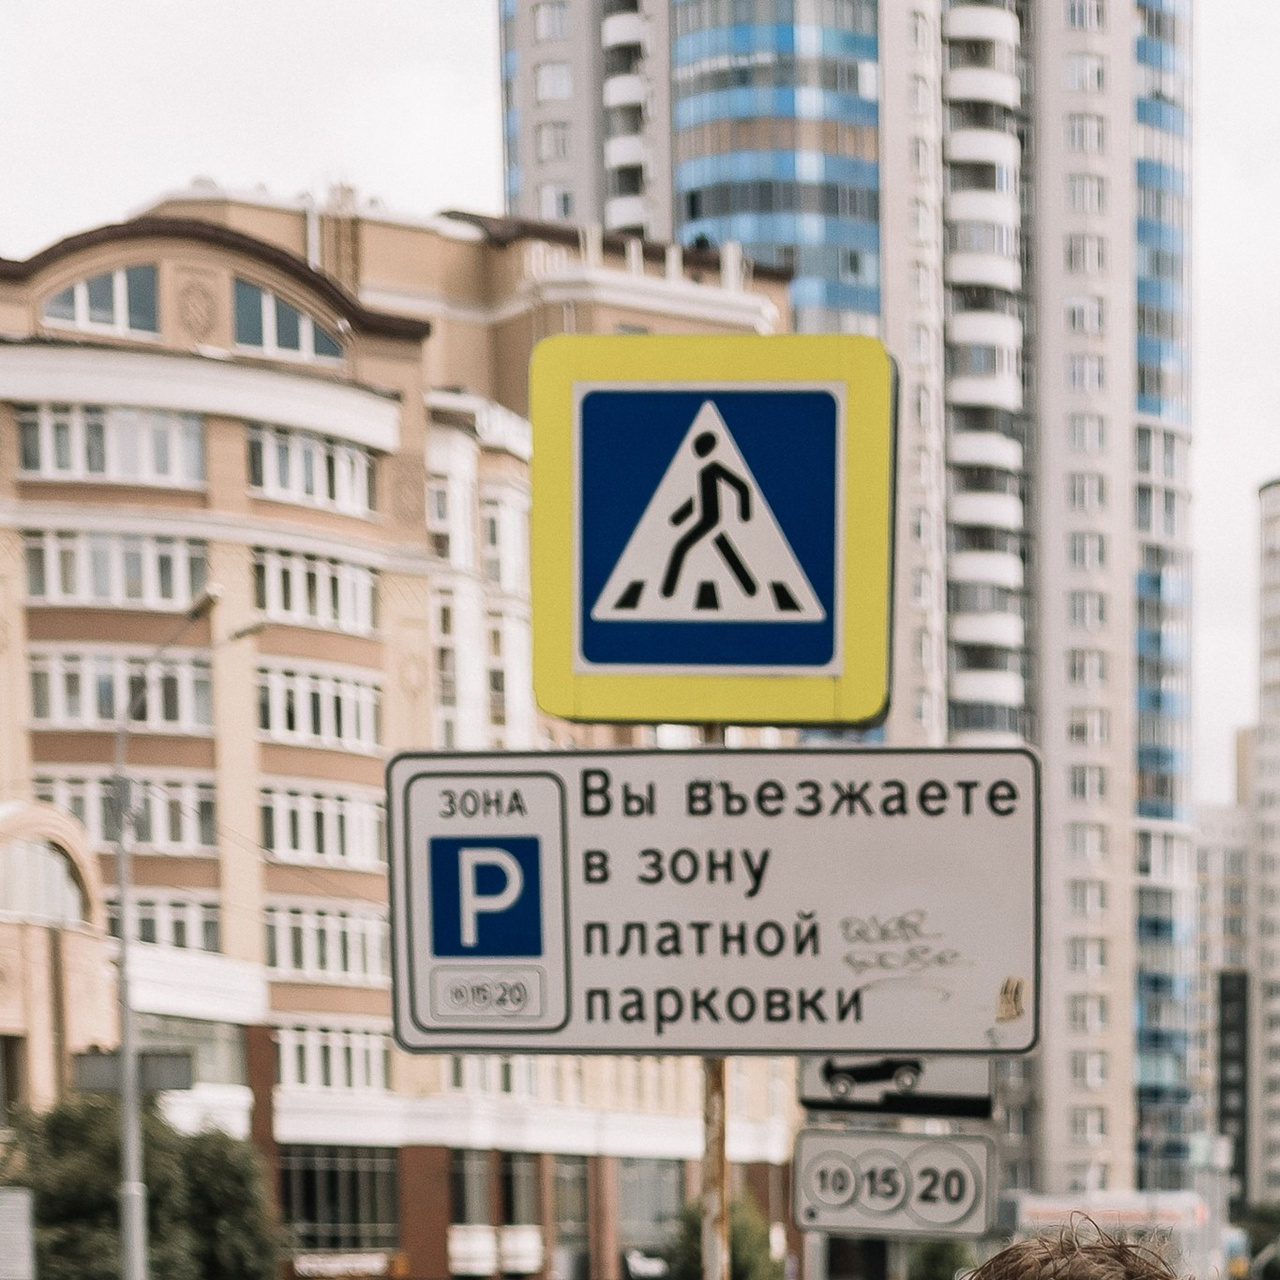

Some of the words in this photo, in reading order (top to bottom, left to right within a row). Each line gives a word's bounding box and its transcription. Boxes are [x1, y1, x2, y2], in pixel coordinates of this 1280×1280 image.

[439, 789, 527, 818] ЗОНА
[580, 769, 656, 817] Вы
[688, 779, 1018, 817] въезжаете
[584, 849, 611, 884] в
[637, 848, 771, 898] зону
[584, 911, 821, 957] платной
[585, 986, 864, 1035] парковки
[818, 1168, 850, 1195] 10
[865, 1167, 899, 1200] 15
[918, 1167, 967, 1205] 20
